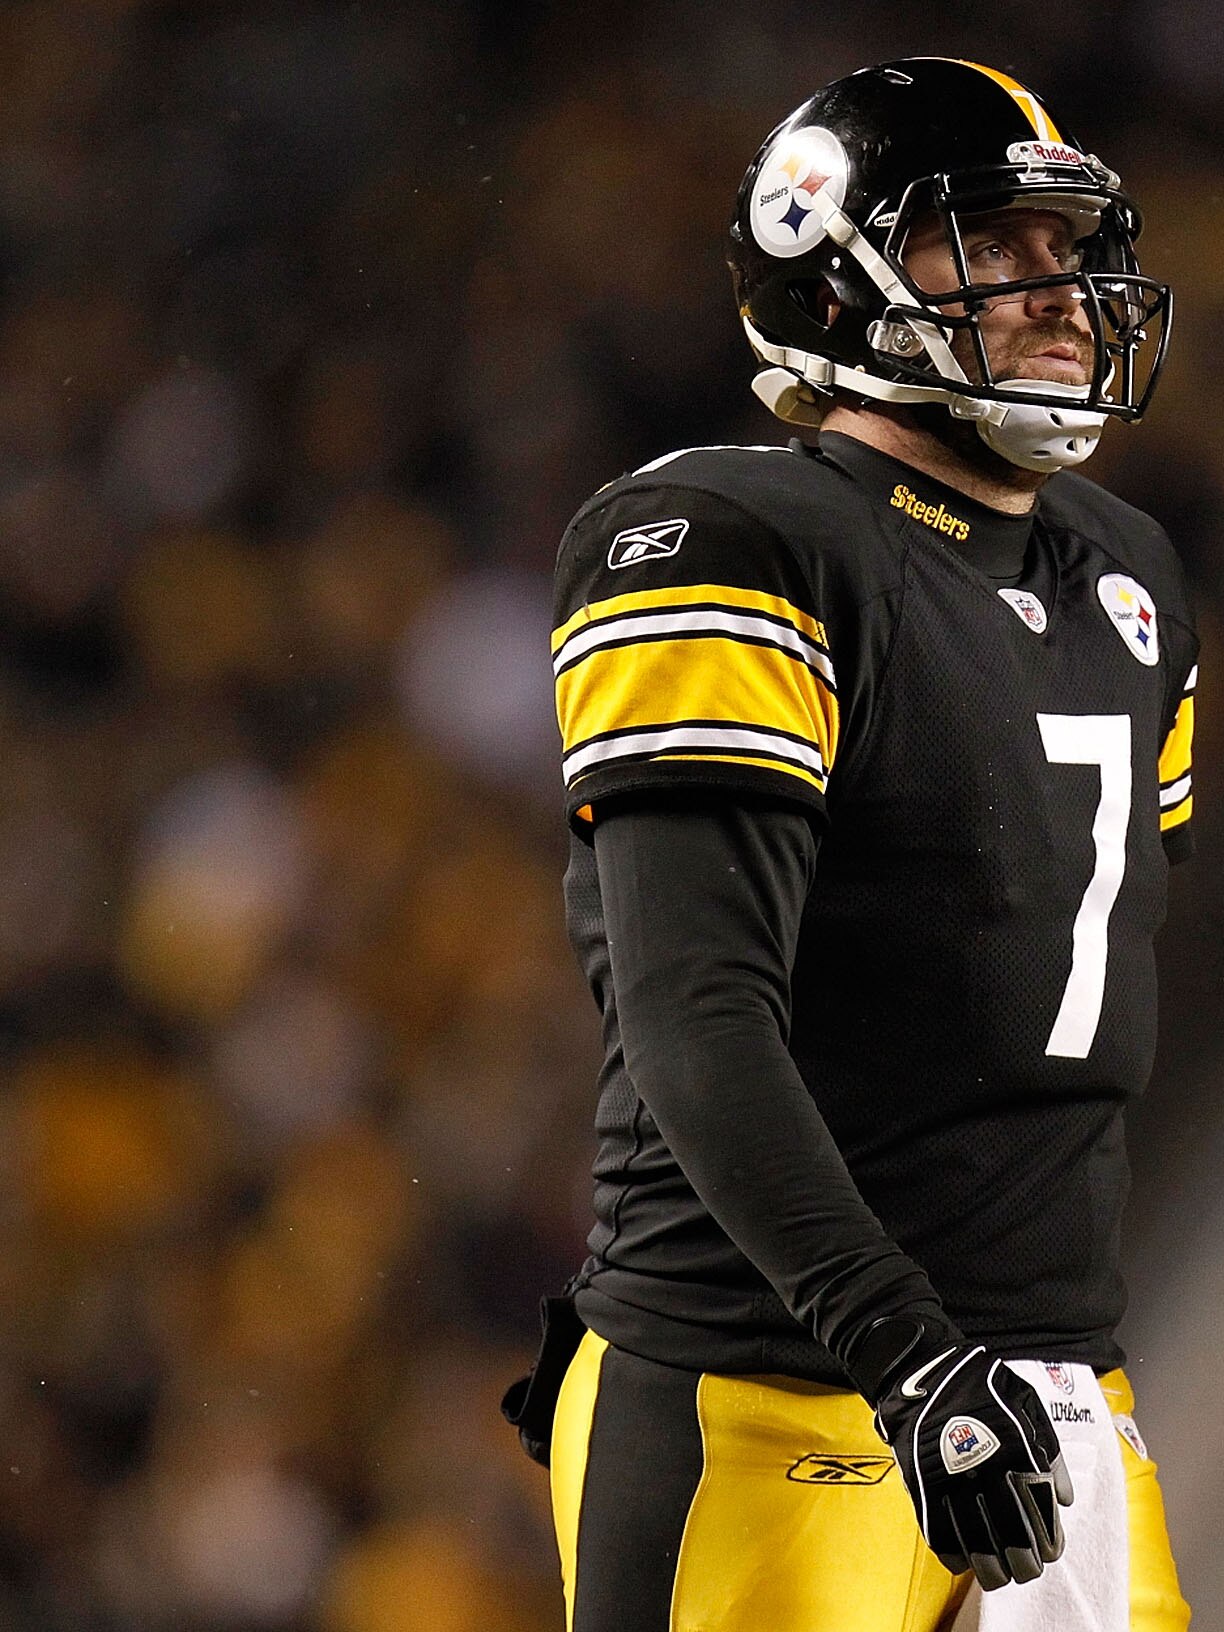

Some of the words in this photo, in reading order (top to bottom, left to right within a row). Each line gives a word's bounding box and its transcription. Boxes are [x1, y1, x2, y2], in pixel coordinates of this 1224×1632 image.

[1010, 89, 1050, 141] 7
[760, 186, 789, 207] Steelers
[876, 215, 895, 226] Ridd
[890, 484, 970, 541] Steelers
[1036, 712, 1132, 1060] 7
[1050, 1401, 1094, 1424] Wilson
[950, 1425, 972, 1446] NFL
